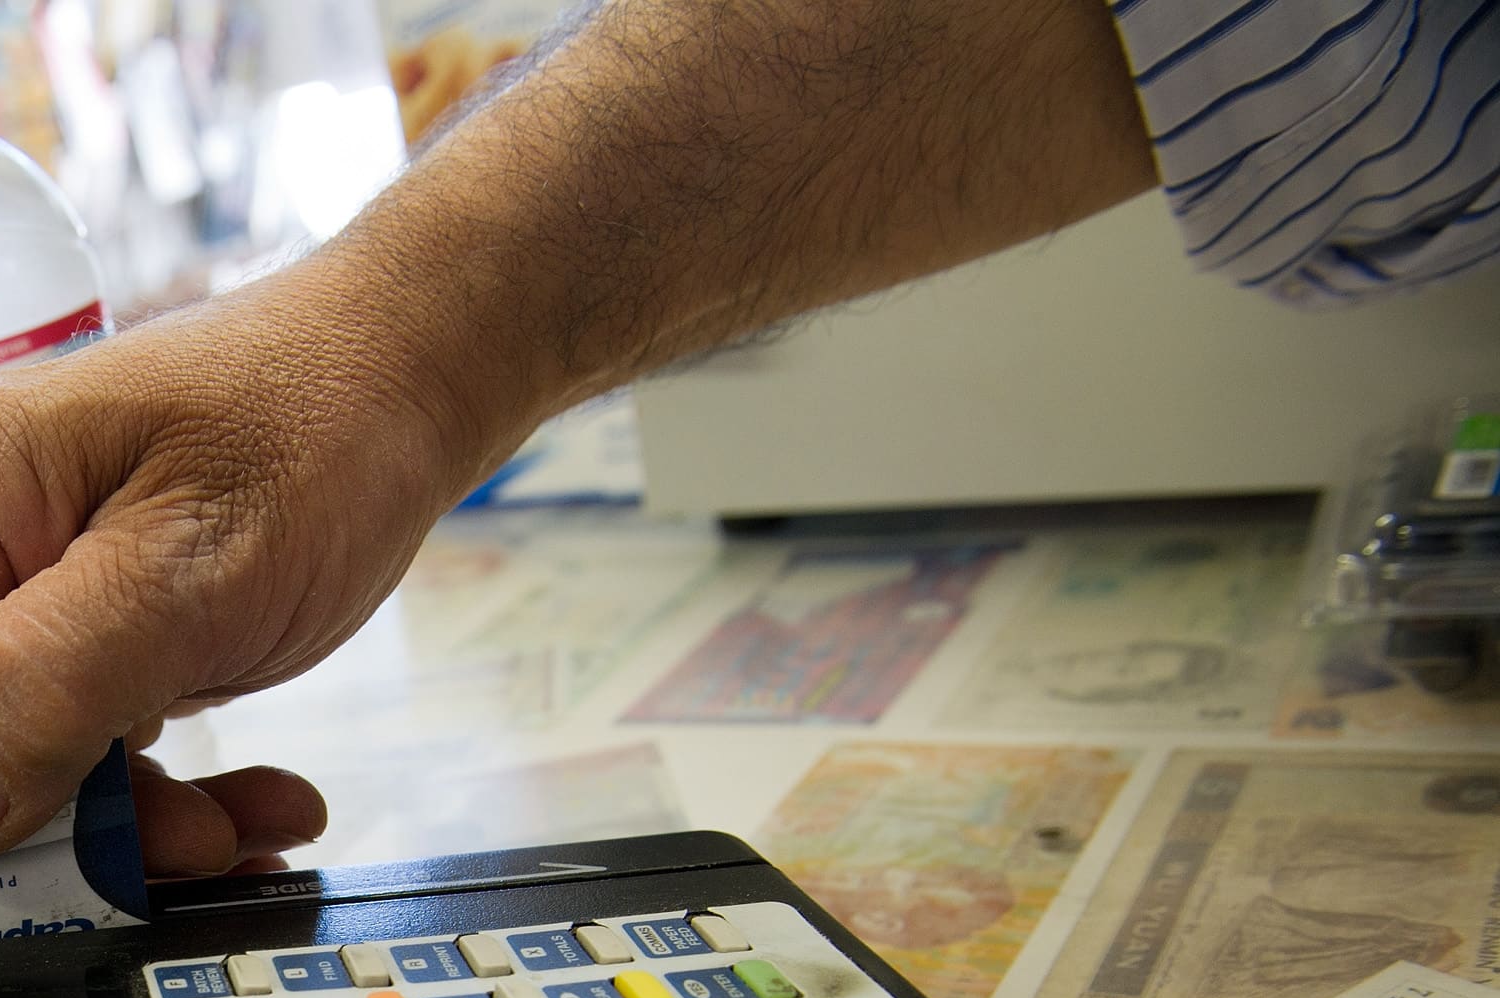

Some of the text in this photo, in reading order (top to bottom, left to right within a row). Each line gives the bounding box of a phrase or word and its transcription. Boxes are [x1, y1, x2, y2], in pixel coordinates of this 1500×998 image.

[259, 881, 322, 897] SIDE
[661, 926, 690, 950] PAPER
[677, 927, 702, 946] FEED
[432, 944, 461, 977] REPRINT
[551, 935, 580, 963] TOTALS
[192, 970, 211, 994] BATCH
[205, 967, 226, 994] REVIEW
[318, 961, 339, 982] FIND
[713, 974, 745, 998] ENTER
